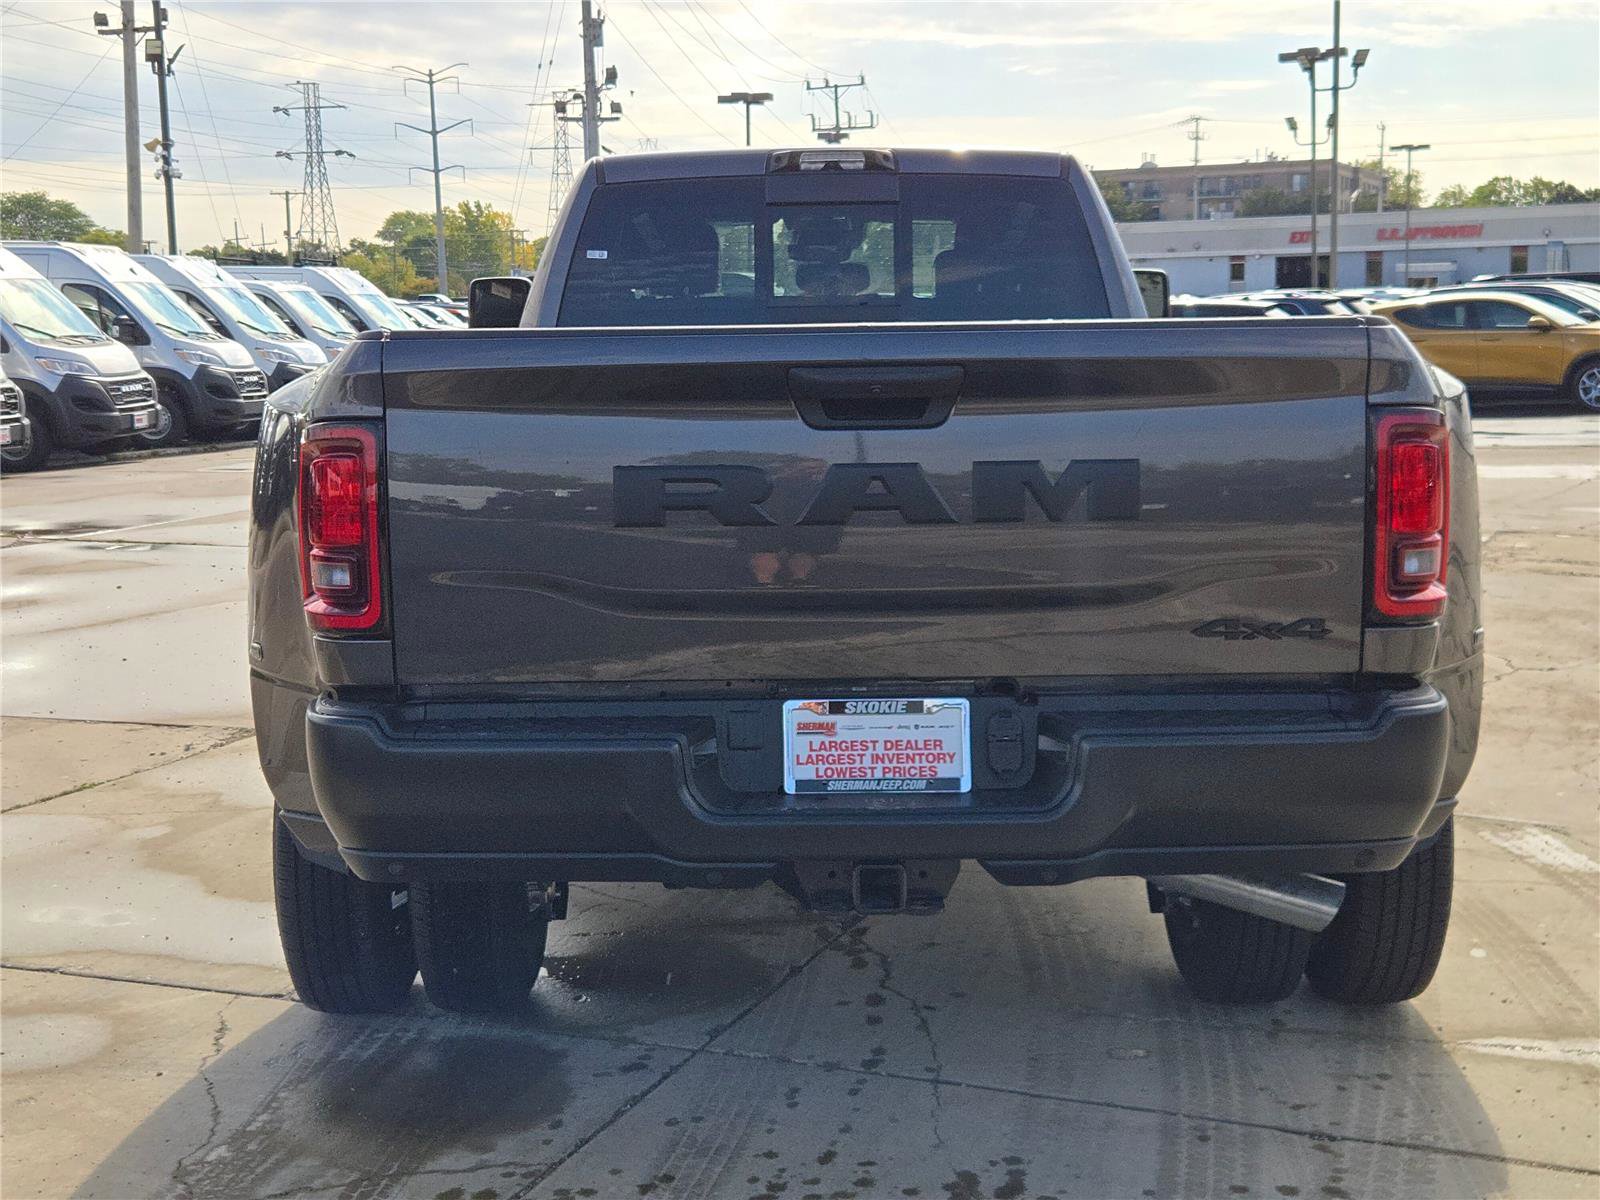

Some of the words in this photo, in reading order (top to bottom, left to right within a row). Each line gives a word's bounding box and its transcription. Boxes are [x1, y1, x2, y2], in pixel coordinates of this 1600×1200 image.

[613, 458, 1140, 527] RAM
[844, 700, 908, 714] SKOKIE
[796, 721, 837, 731] SHERMAN
[809, 740, 879, 753] LARGEST
[883, 739, 943, 752] DEALER
[796, 753, 866, 766] LARGEST
[871, 752, 956, 765] INVENTORY
[815, 766, 877, 779] LOWEST
[882, 765, 938, 778] PRICES
[827, 779, 927, 791] SHERMANJEEP.COM
